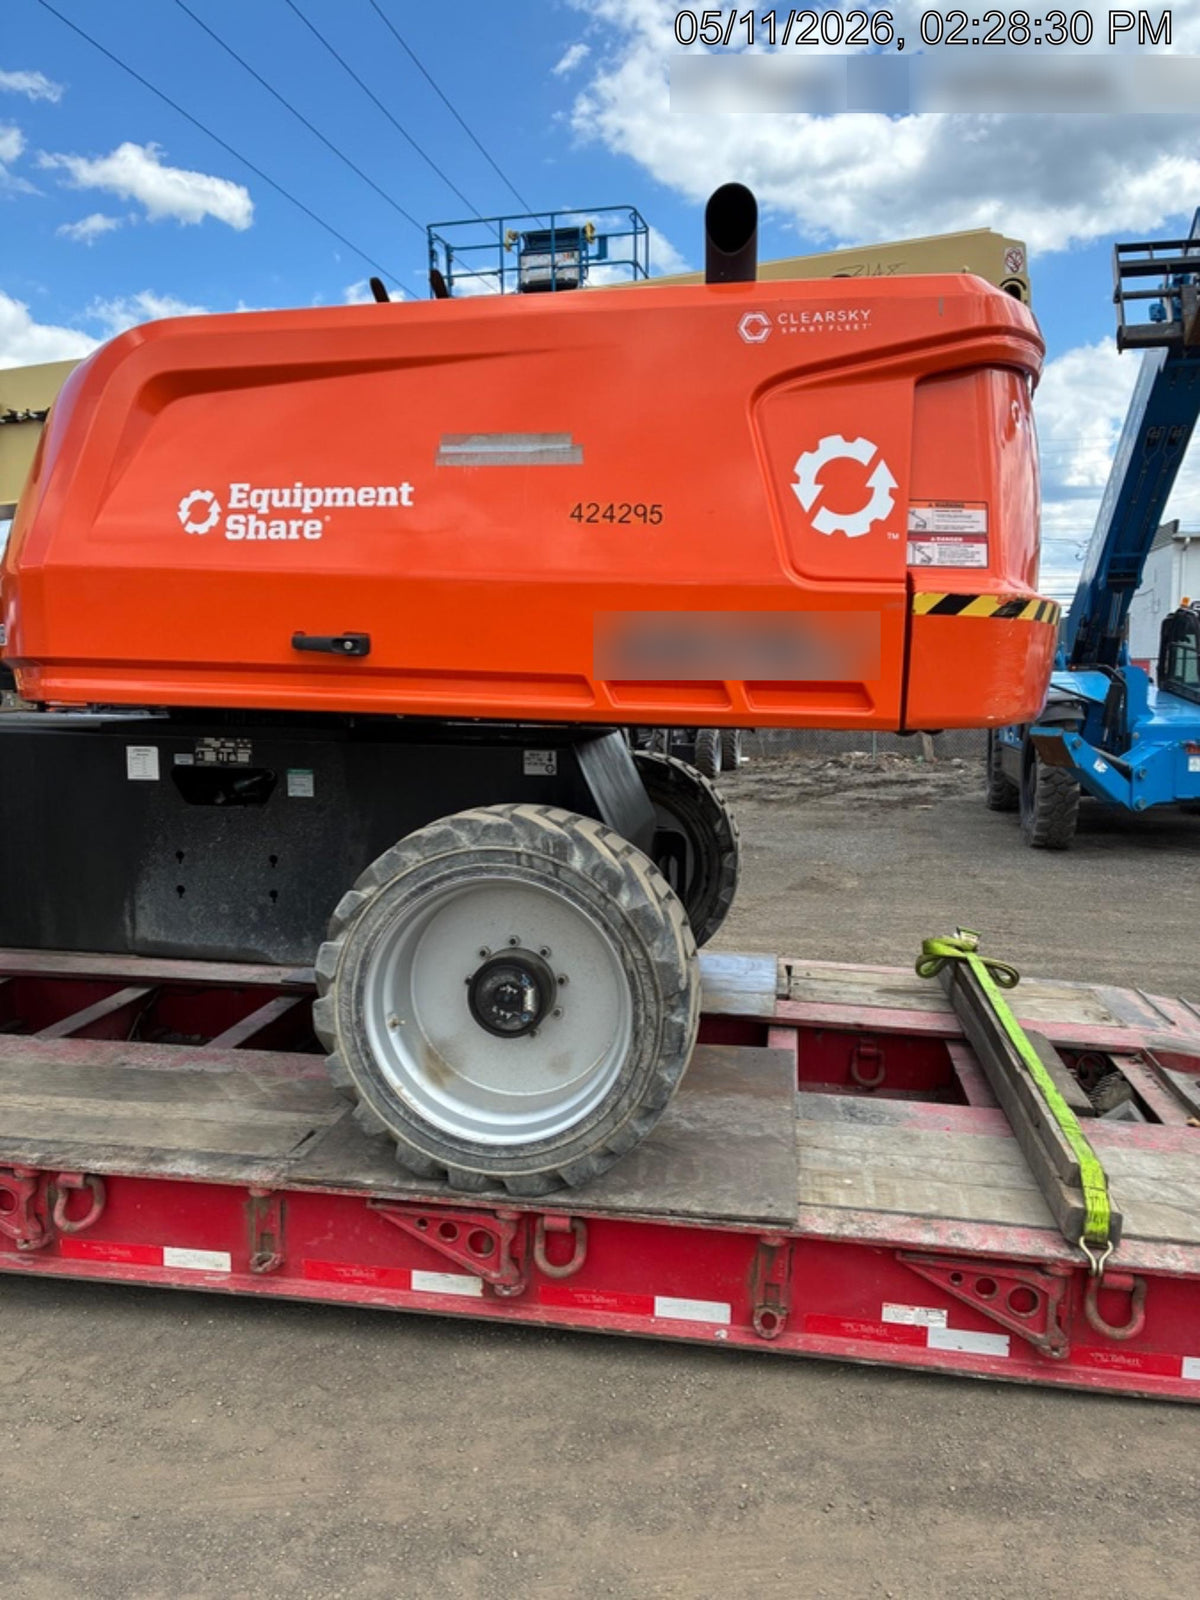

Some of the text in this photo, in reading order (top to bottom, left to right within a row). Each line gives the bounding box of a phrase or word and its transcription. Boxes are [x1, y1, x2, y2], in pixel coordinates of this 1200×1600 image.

[777, 309, 872, 325] CLEARSKY
[781, 323, 869, 334] SMART FLEET
[228, 482, 414, 514] Equipment
[569, 502, 663, 525] 424295
